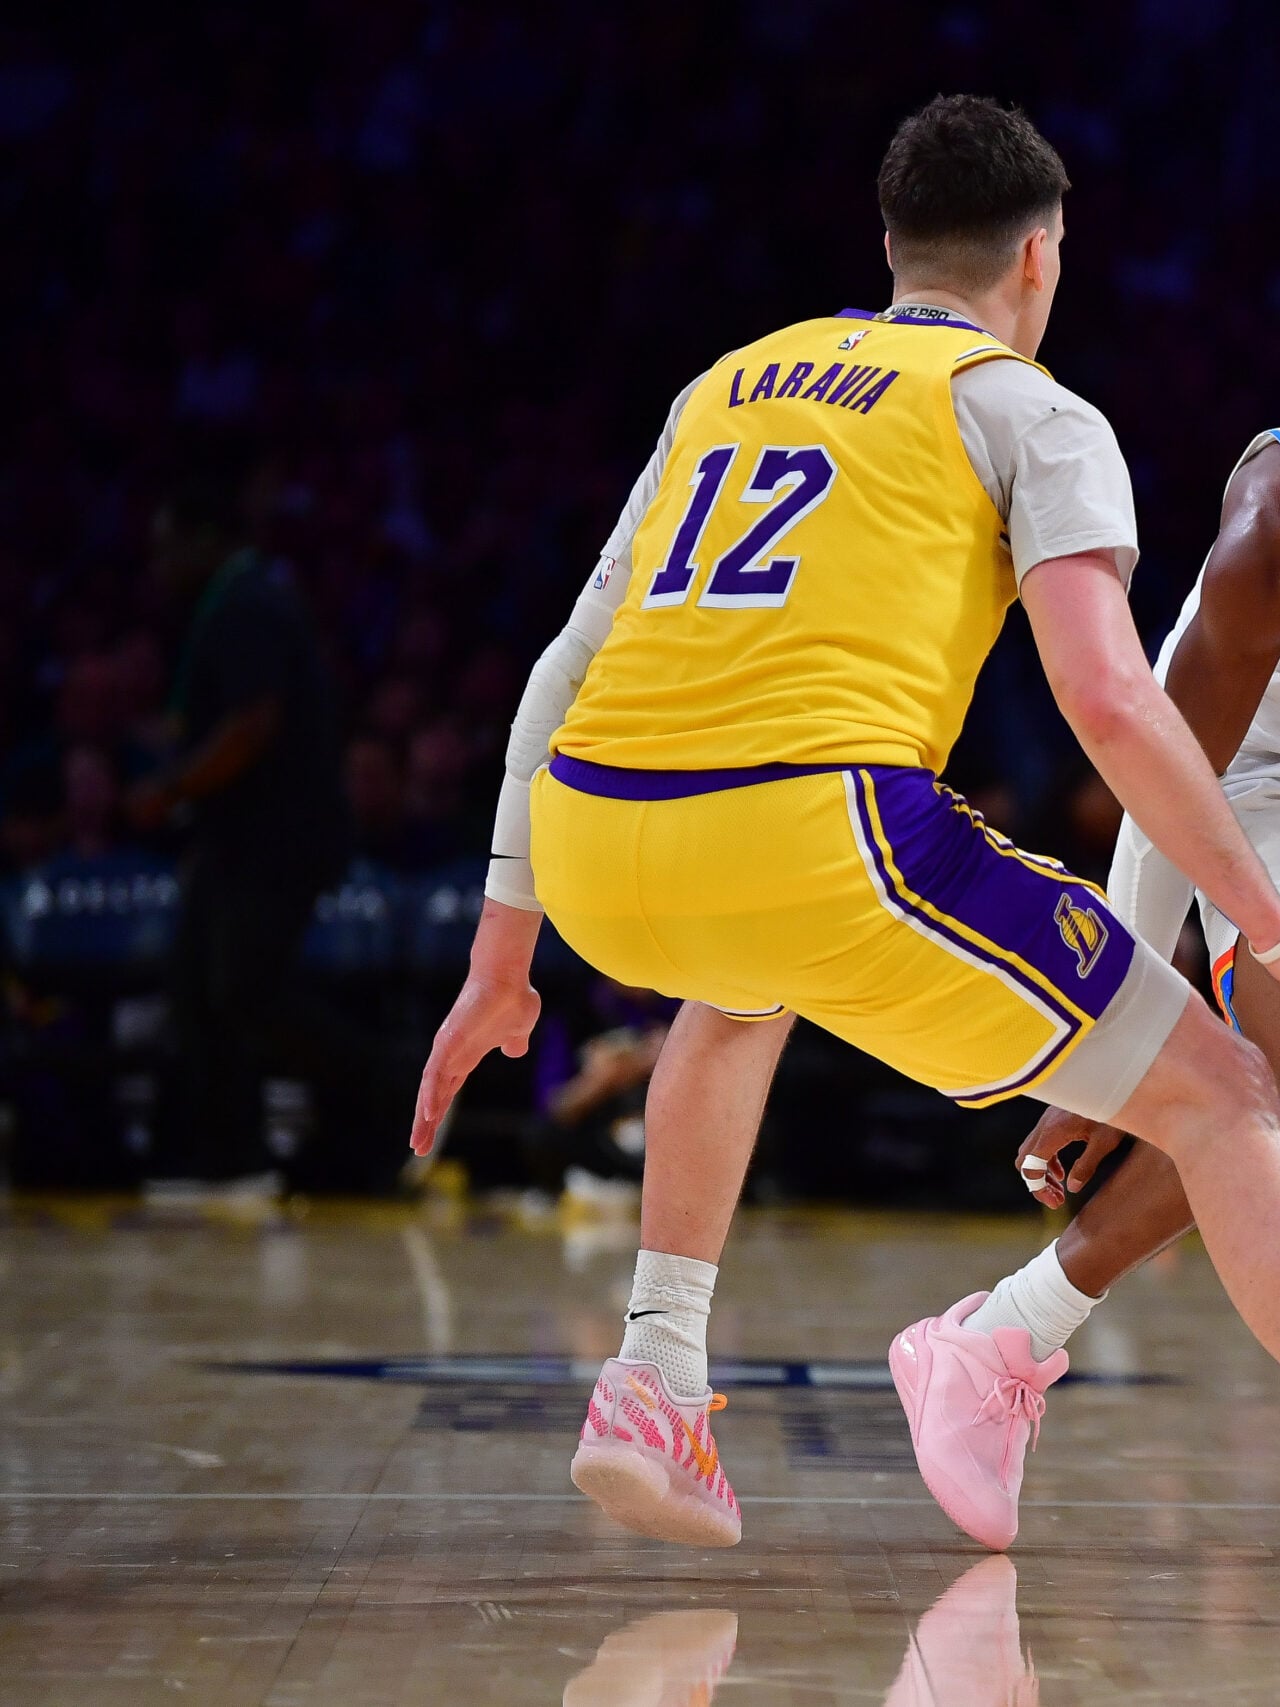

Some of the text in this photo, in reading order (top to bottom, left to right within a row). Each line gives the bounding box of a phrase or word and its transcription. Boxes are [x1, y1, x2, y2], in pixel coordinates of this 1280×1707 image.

[918, 308, 950, 320] PRO
[728, 362, 900, 415] LARAVIA
[640, 442, 839, 609] 12
